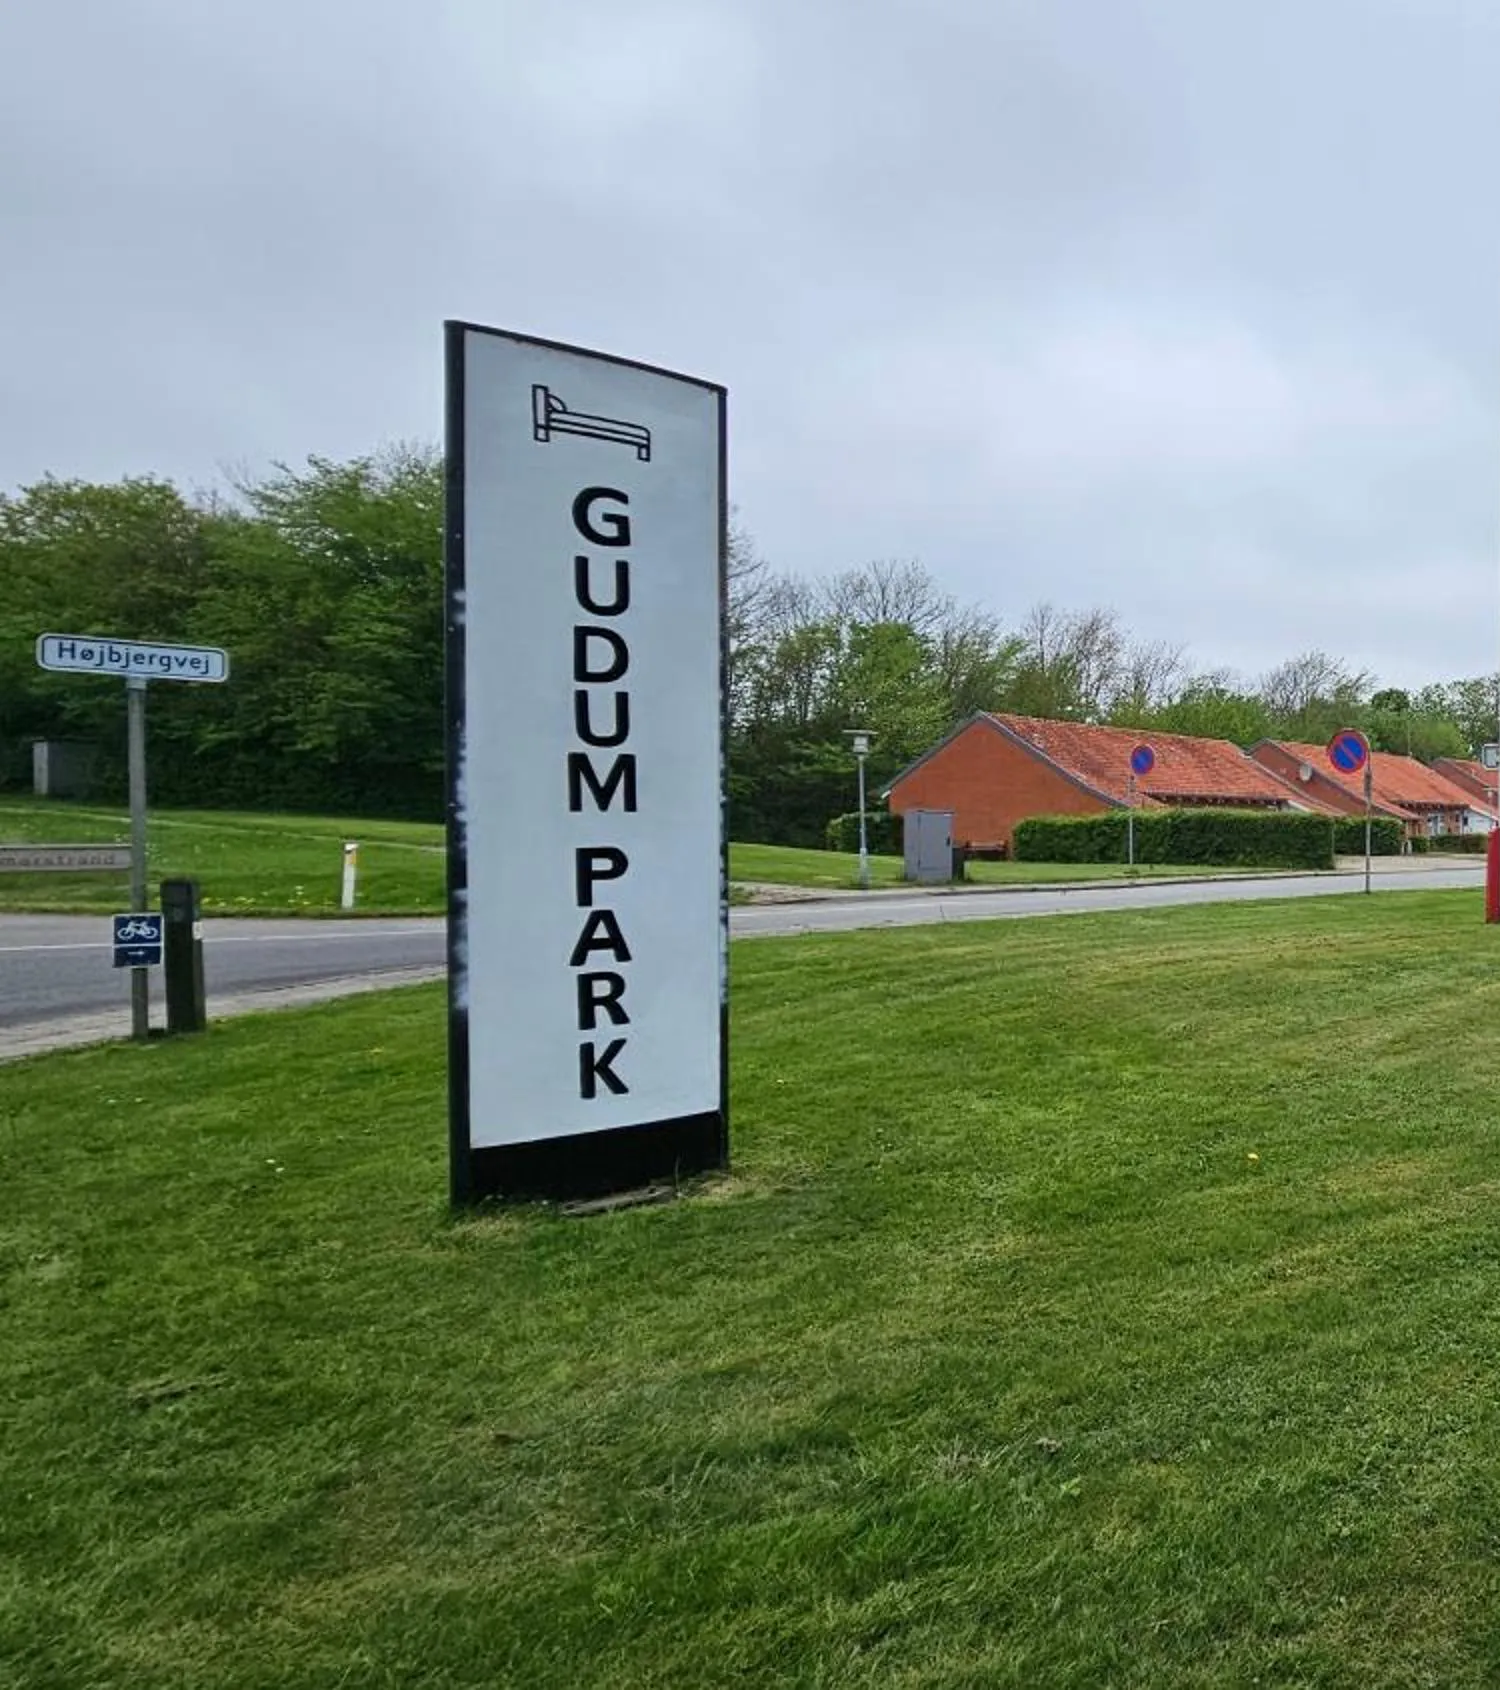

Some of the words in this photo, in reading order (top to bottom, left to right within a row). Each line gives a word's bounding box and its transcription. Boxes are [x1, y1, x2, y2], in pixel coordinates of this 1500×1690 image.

[57, 641, 209, 675] Højbjergvej
[567, 486, 638, 813] GUDUM
[569, 846, 633, 1100] PARK
